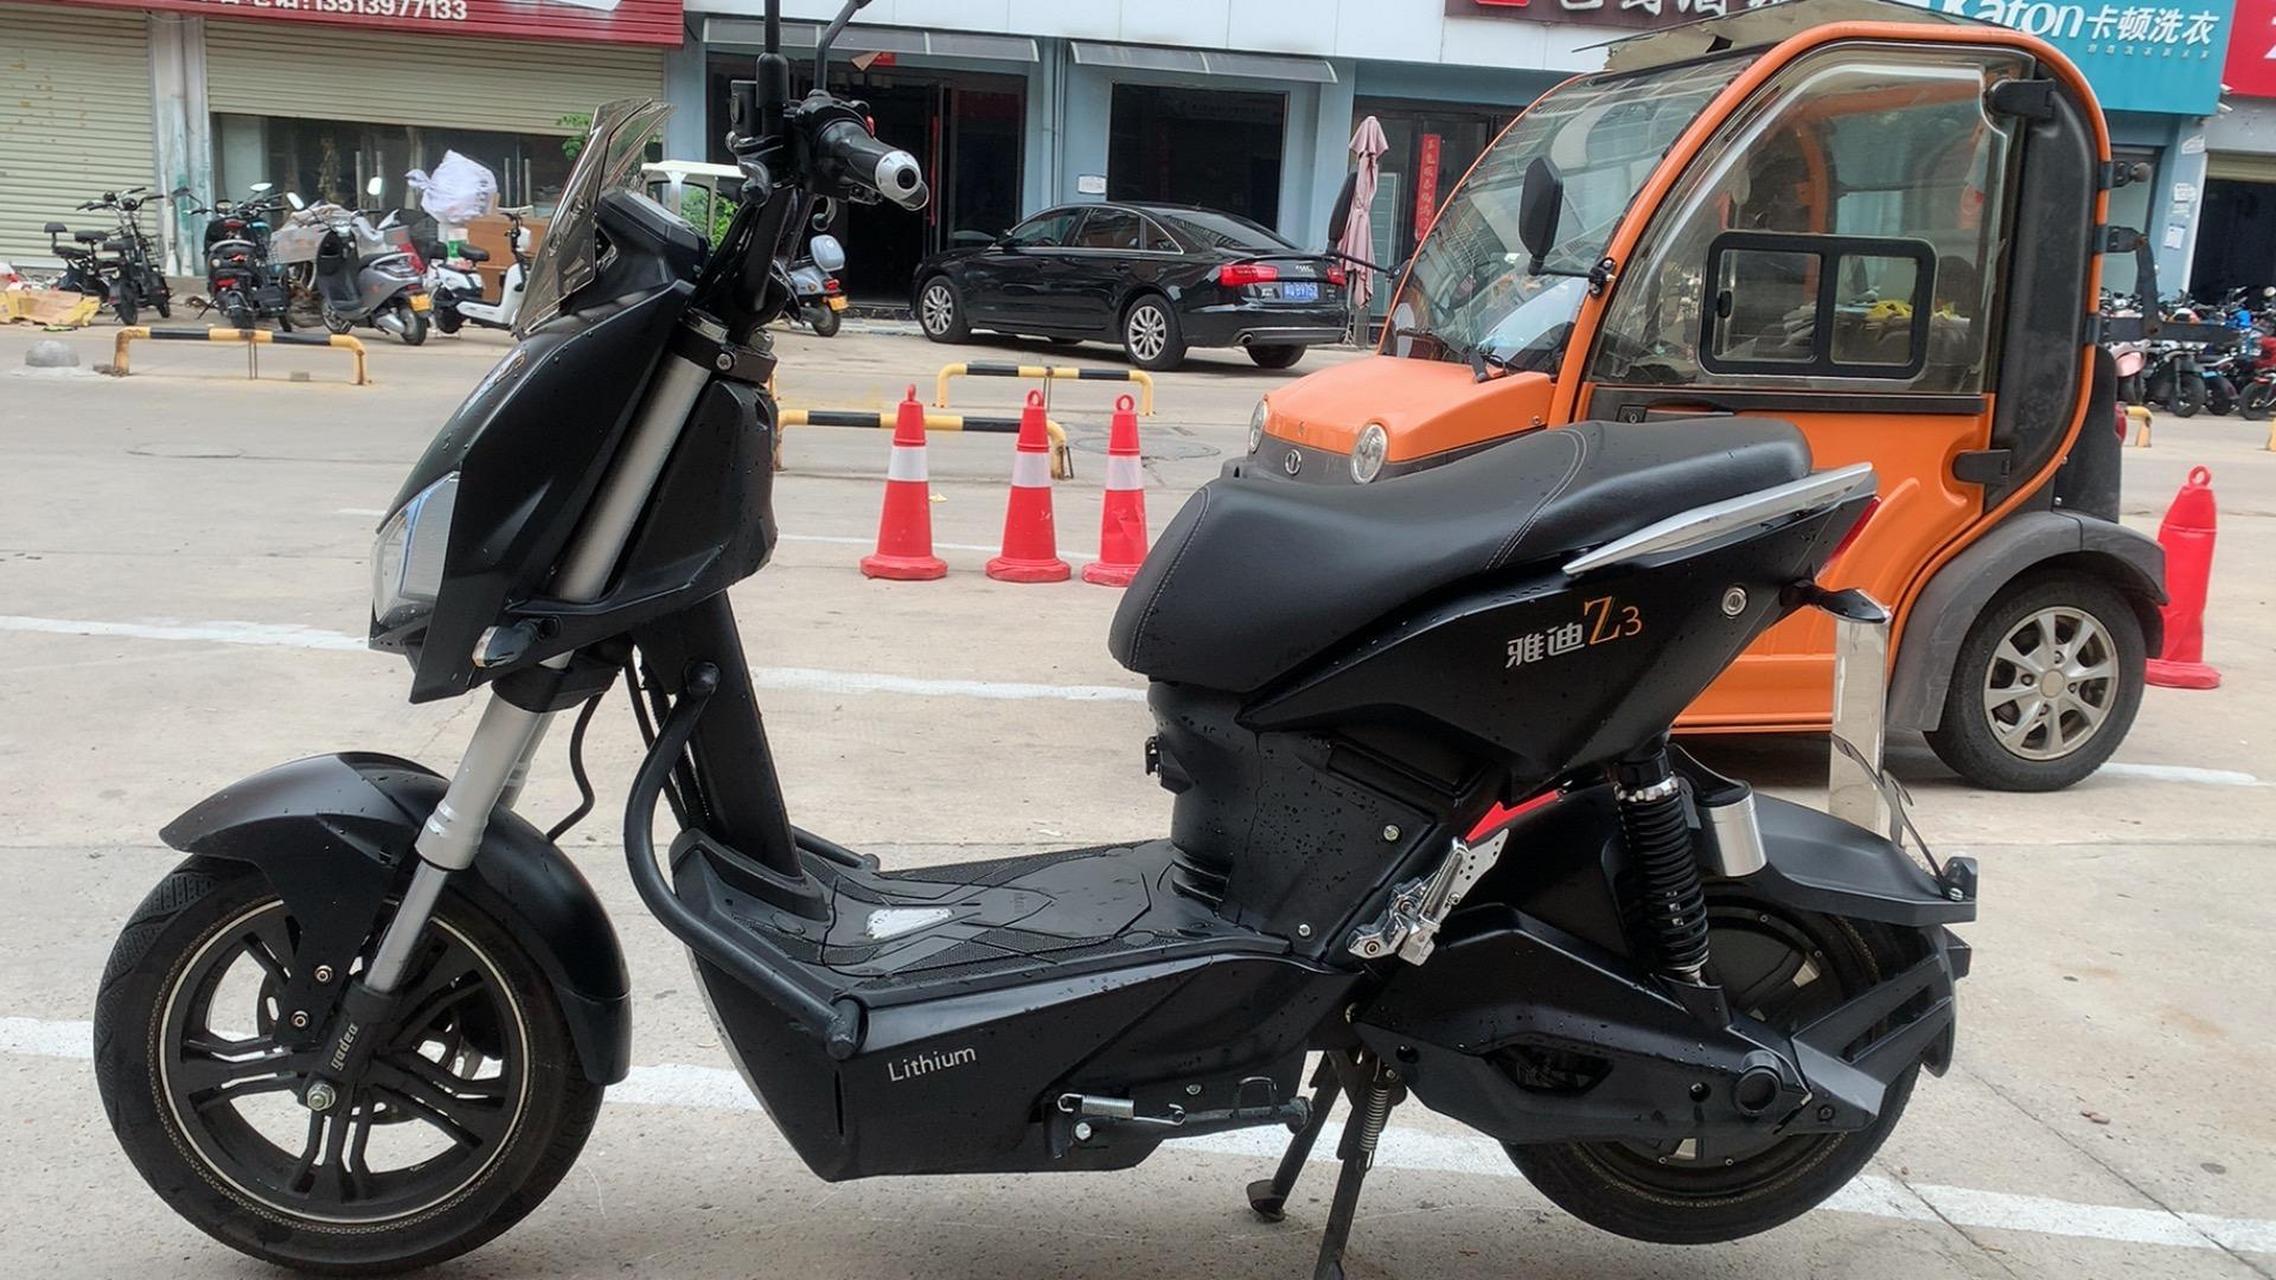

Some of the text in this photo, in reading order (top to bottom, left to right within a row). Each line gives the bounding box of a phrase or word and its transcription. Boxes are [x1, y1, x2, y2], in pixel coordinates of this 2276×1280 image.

[2086, 6, 2220, 46] 卡顿洗衣
[1505, 595, 1643, 669] 雅迪 Z3
[331, 1022, 359, 1072] yadea
[887, 1047, 976, 1082] Lithium
